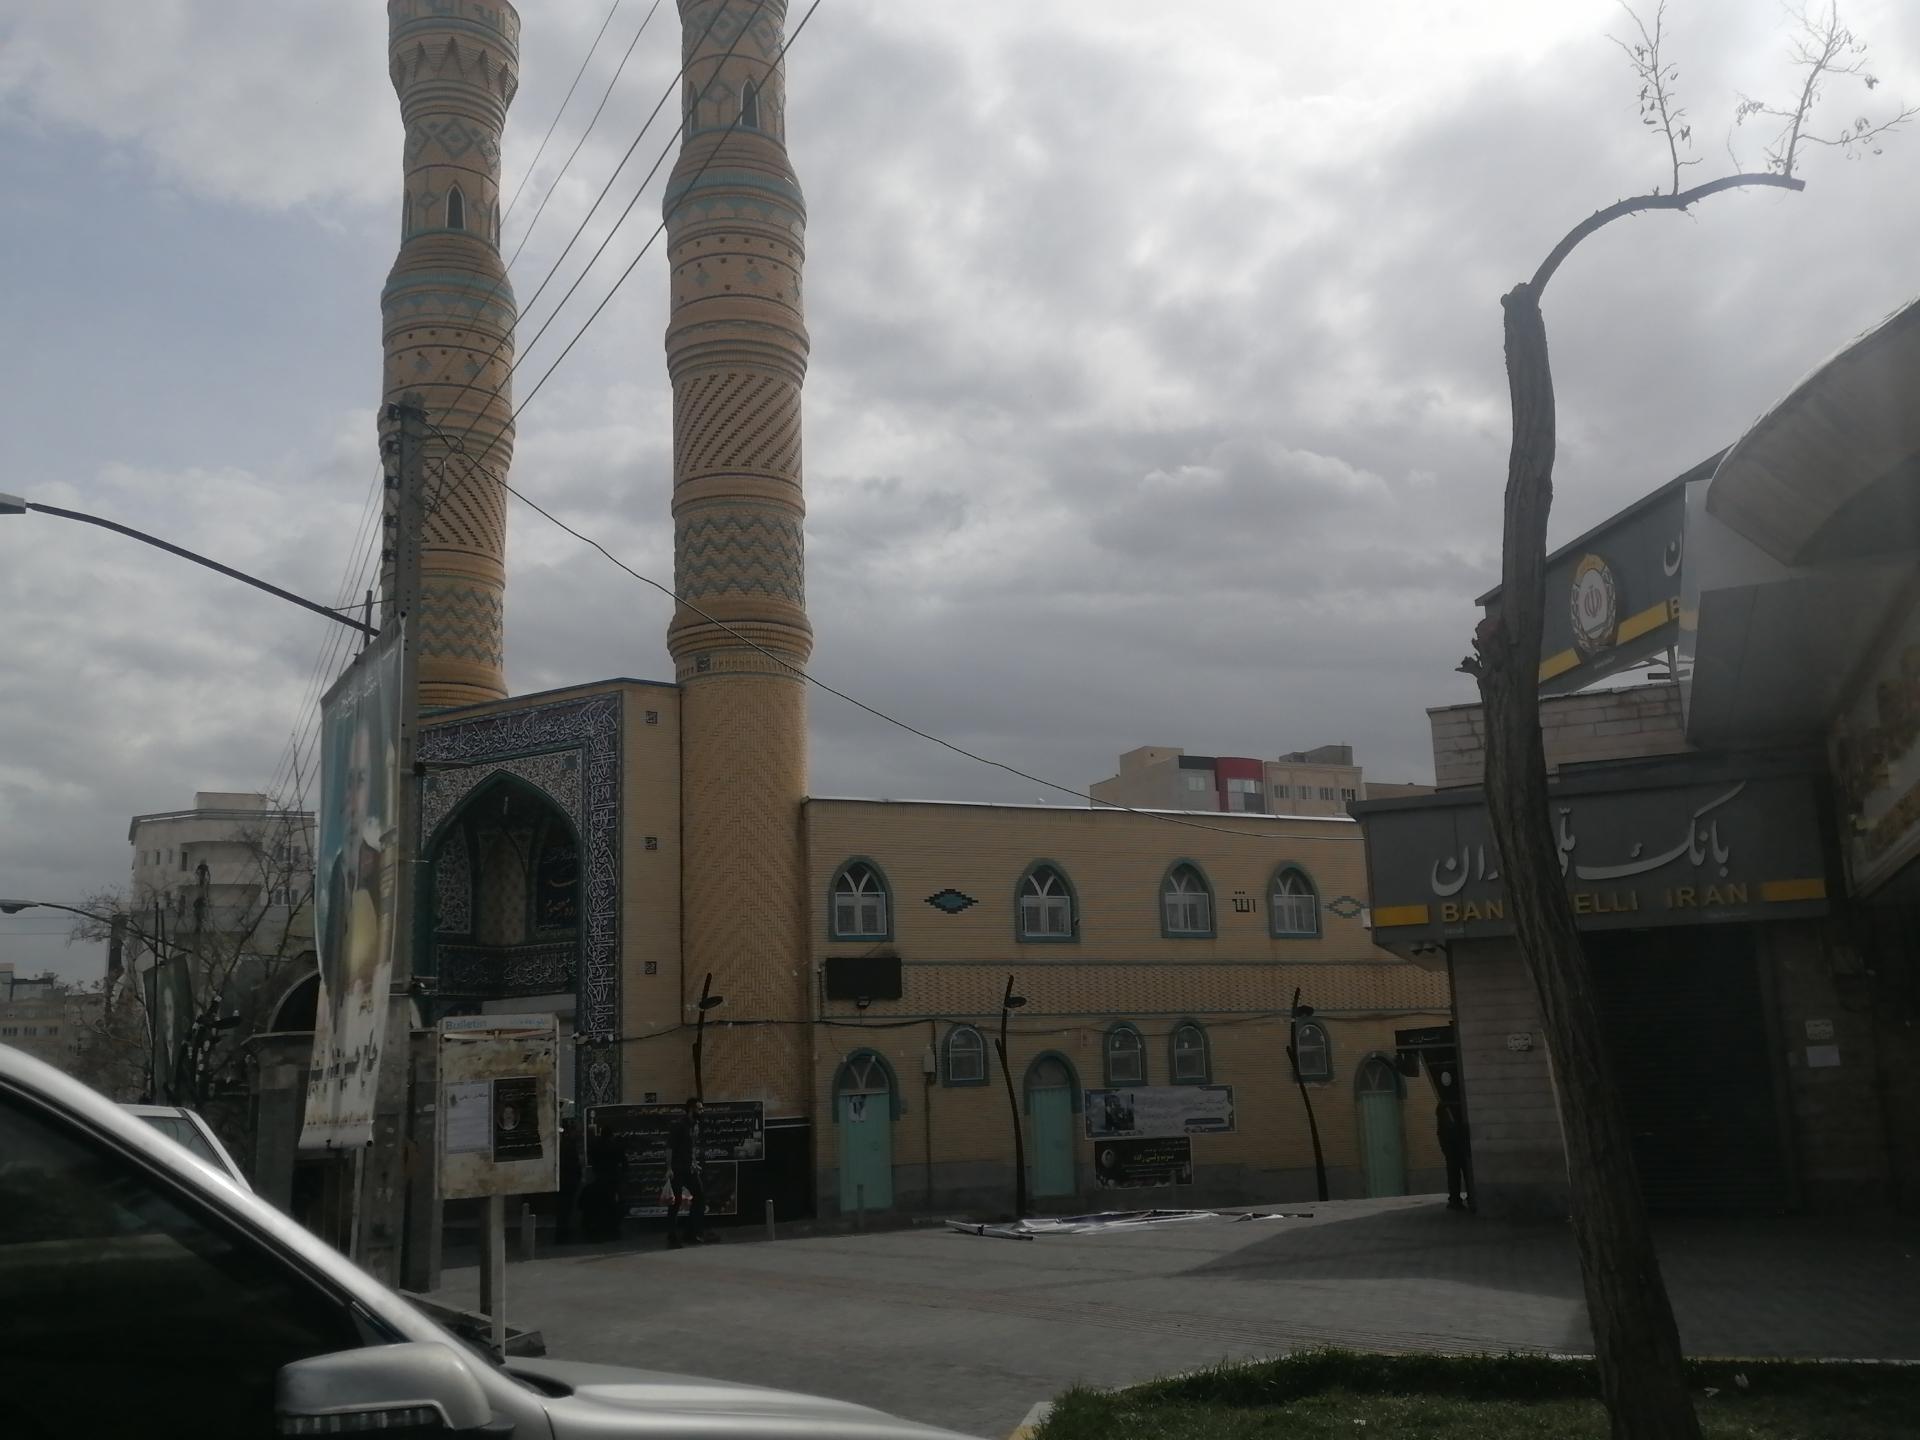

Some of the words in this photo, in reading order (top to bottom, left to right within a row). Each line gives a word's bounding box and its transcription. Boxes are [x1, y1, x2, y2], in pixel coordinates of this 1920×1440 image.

[1440, 899, 1504, 922] BAN
[1575, 889, 1639, 914] ELLI
[1664, 882, 1749, 908] IRAN
